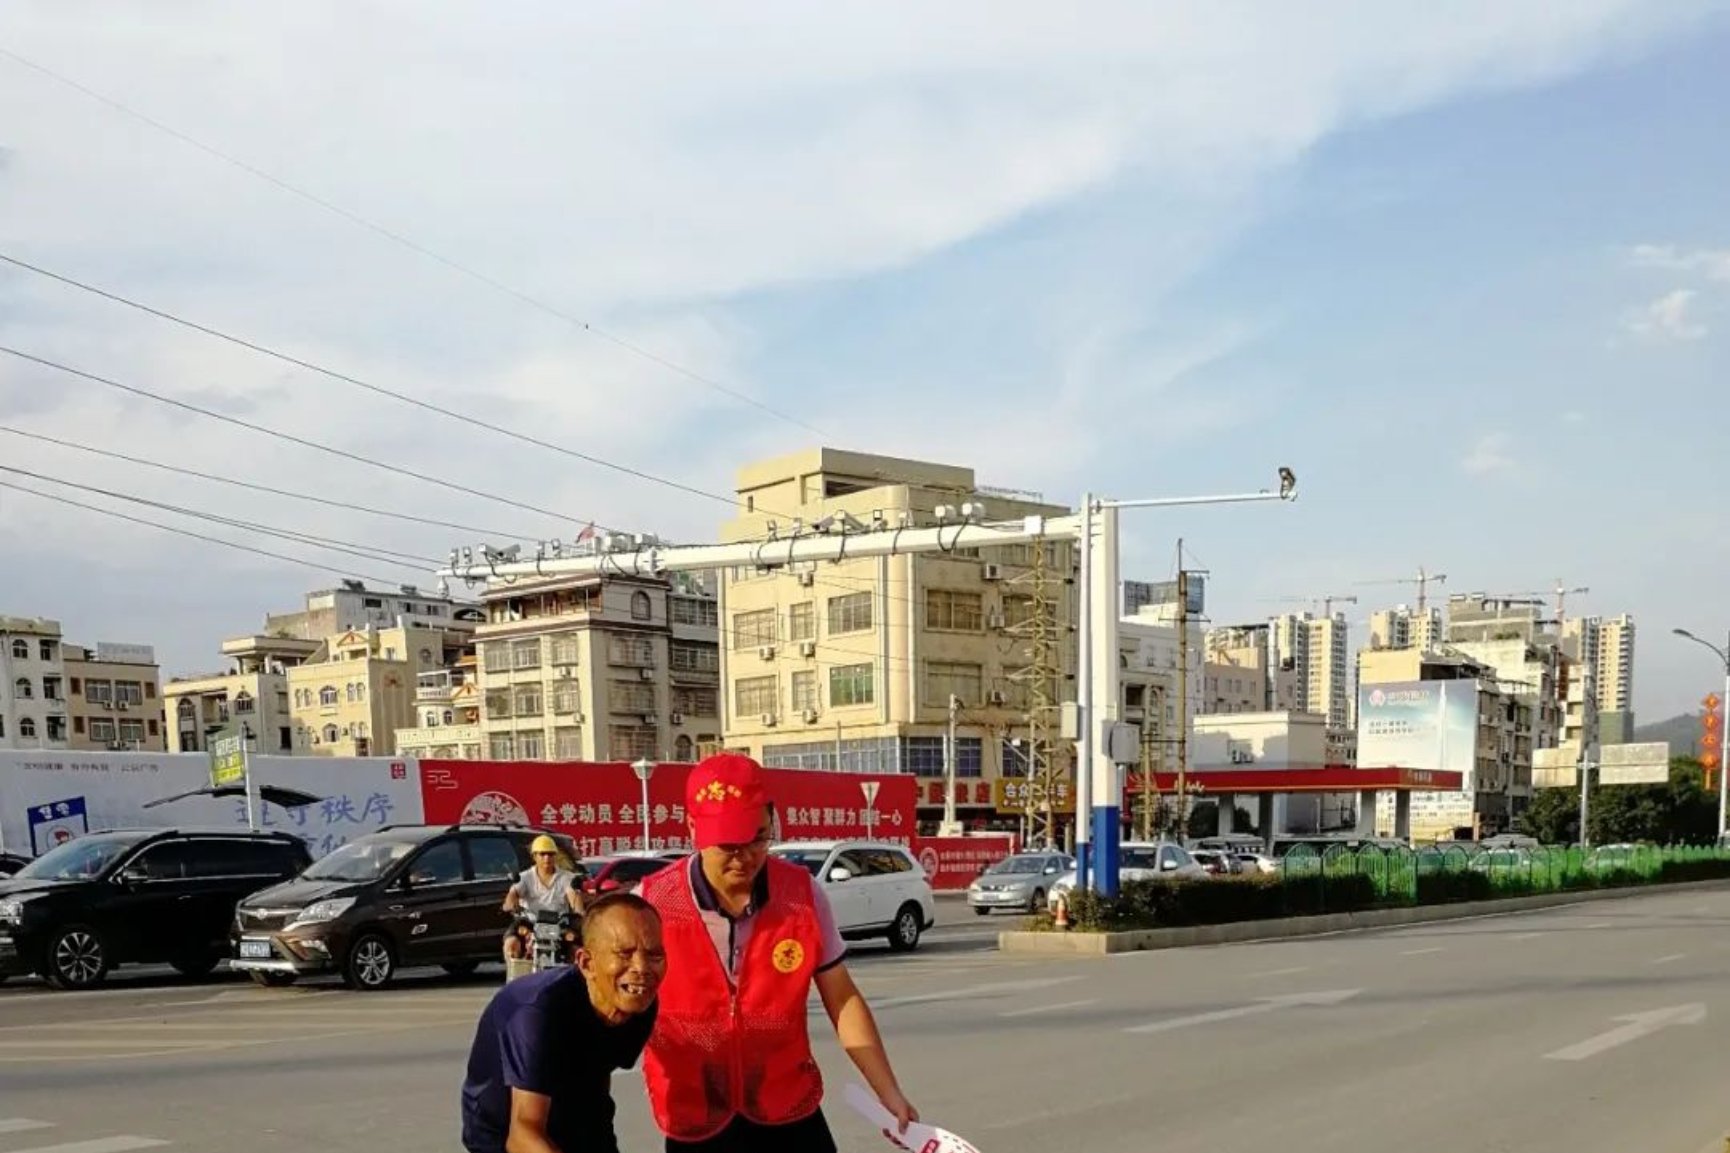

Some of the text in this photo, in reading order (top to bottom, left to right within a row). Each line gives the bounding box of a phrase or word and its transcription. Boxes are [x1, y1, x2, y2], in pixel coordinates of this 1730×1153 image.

[540, 803, 685, 825] 全党动员 全民参与
[786, 806, 821, 827] 集众智
[572, 835, 693, 857] 打赢脱贫攻坚
